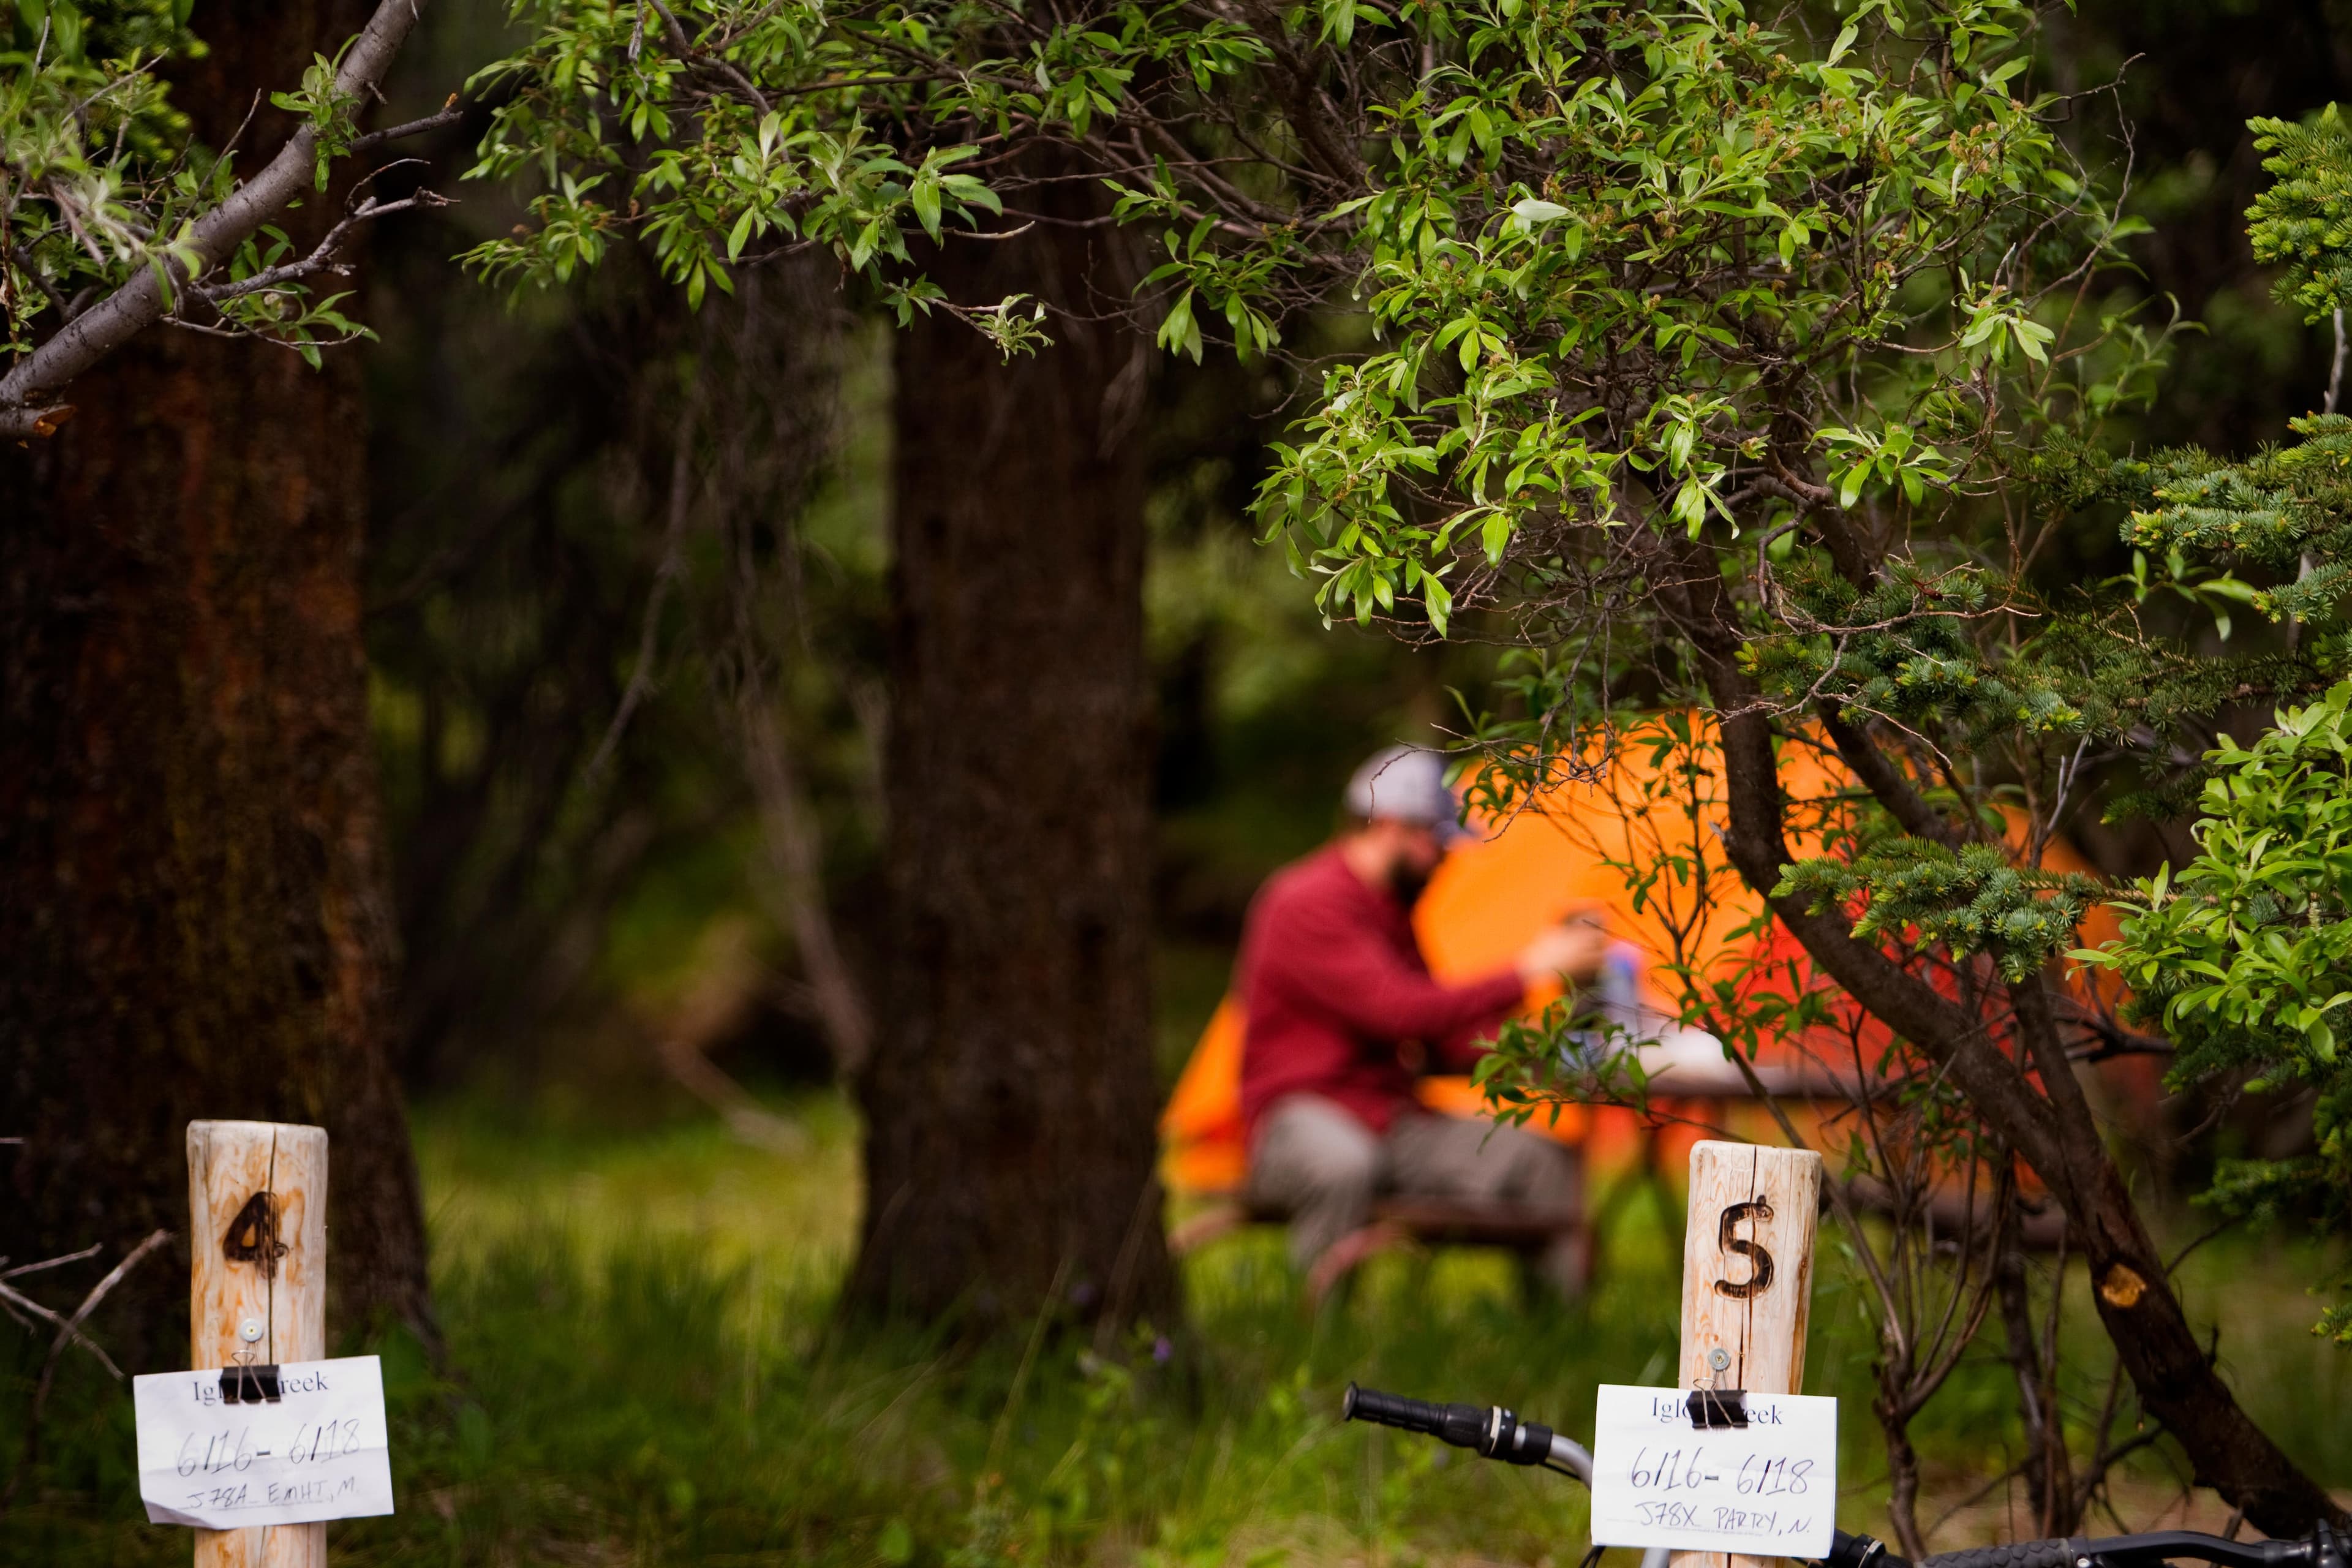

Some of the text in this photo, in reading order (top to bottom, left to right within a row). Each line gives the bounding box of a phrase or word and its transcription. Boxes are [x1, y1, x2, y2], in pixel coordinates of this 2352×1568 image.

[223, 1191, 290, 1280] 4
[279, 1371, 328, 1394] reek
[1653, 1397, 1692, 1423] Igl
[1737, 1453, 1814, 1496] 6/18
